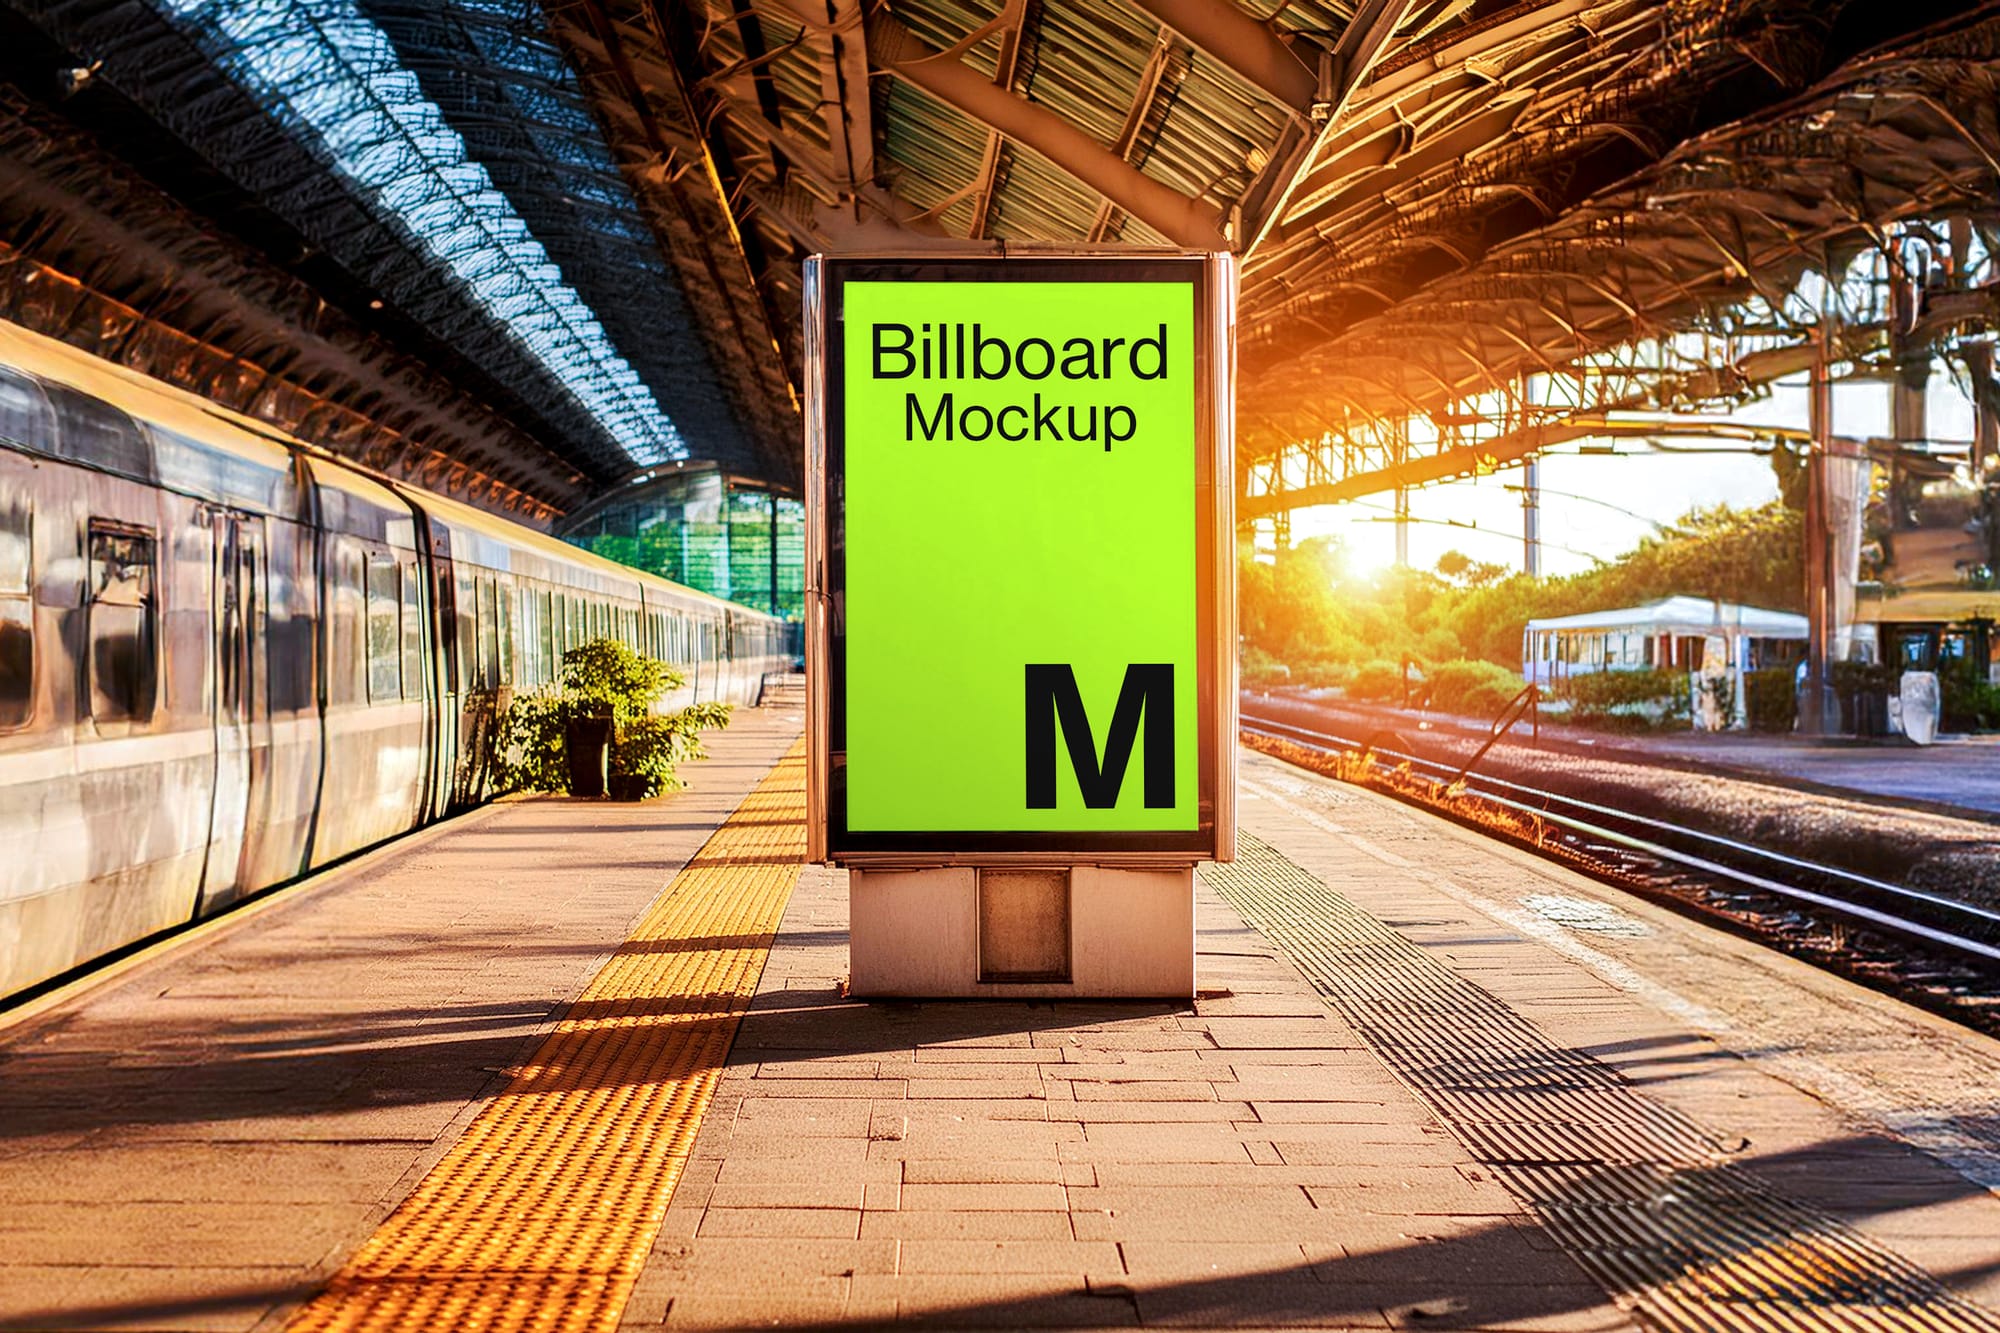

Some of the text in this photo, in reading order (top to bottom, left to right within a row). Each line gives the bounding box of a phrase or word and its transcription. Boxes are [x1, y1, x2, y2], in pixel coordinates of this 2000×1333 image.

[872, 323, 1168, 381] Billboard
[905, 392, 1137, 452] Mockup
[1024, 663, 1176, 810] M
